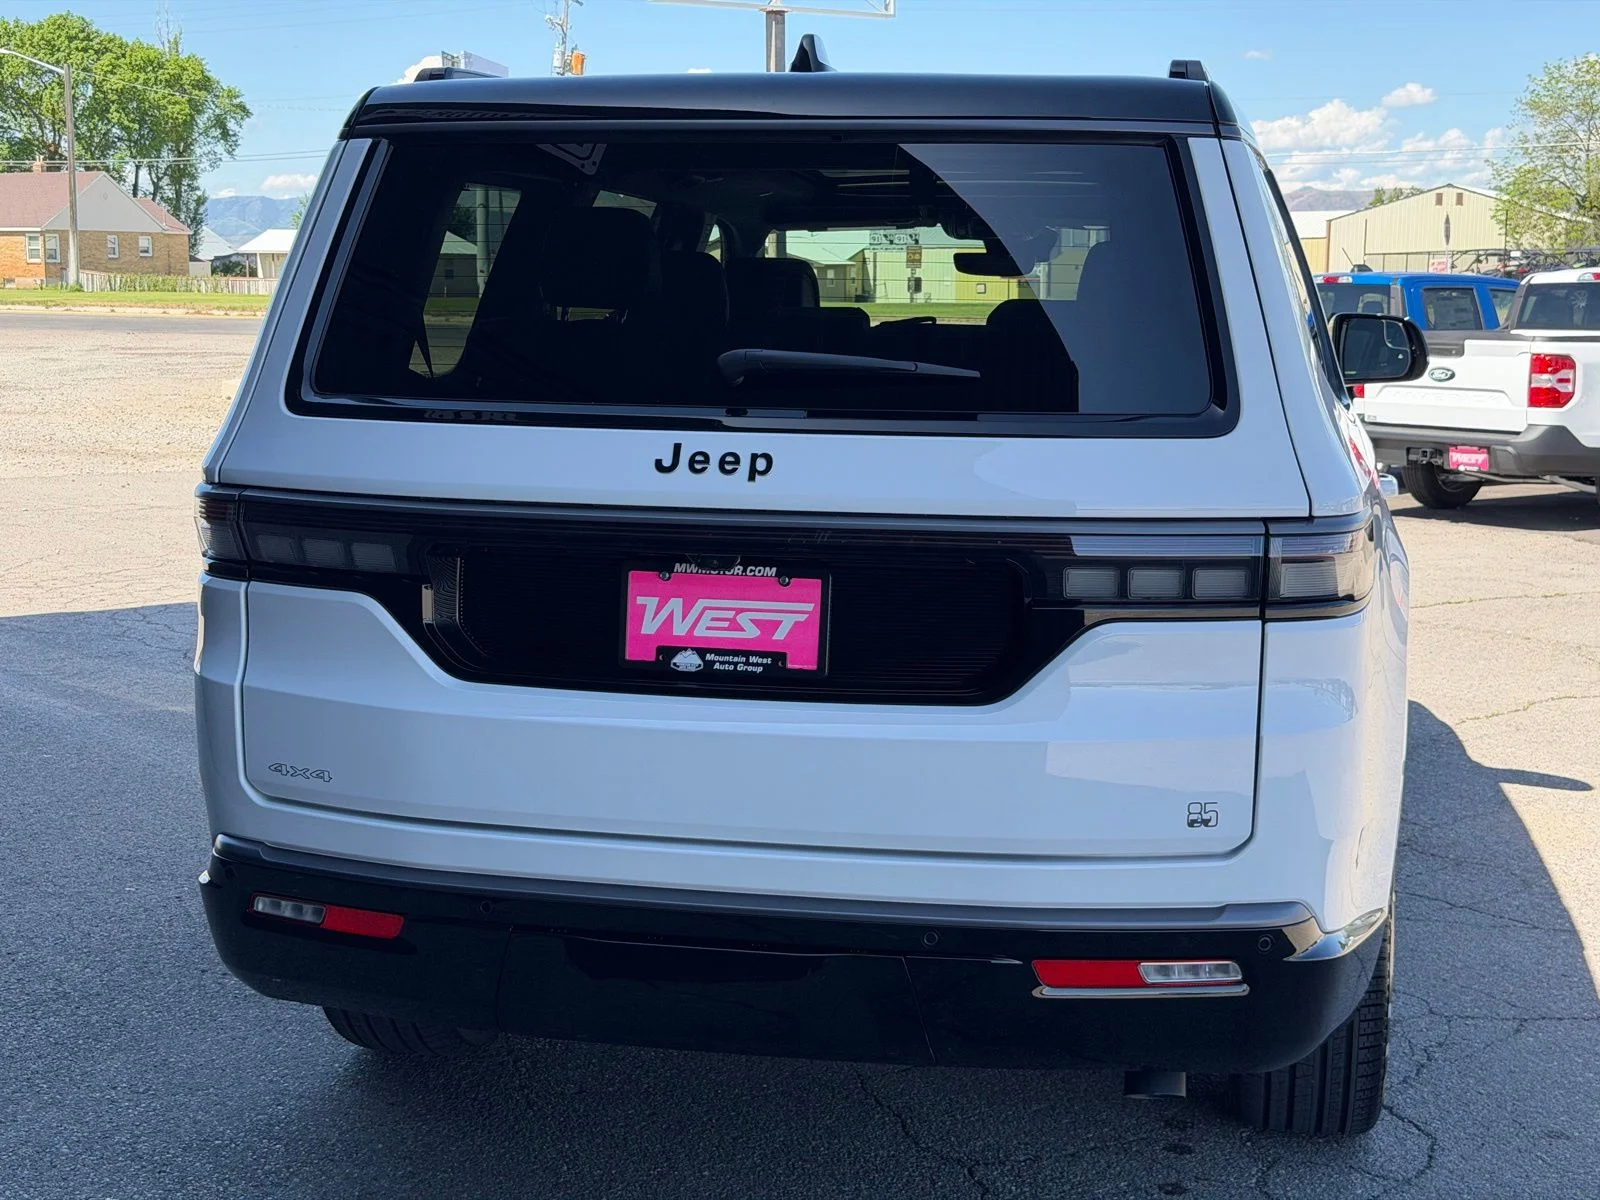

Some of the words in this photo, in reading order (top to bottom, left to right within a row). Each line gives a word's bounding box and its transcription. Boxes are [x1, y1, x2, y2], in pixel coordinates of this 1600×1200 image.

[654, 442, 774, 482] Jeep
[636, 596, 815, 640] WEST
[705, 653, 747, 663] Mountain
[748, 655, 773, 665] West
[713, 662, 735, 671] Auto
[736, 663, 764, 674] Group
[1187, 801, 1219, 828] 85
